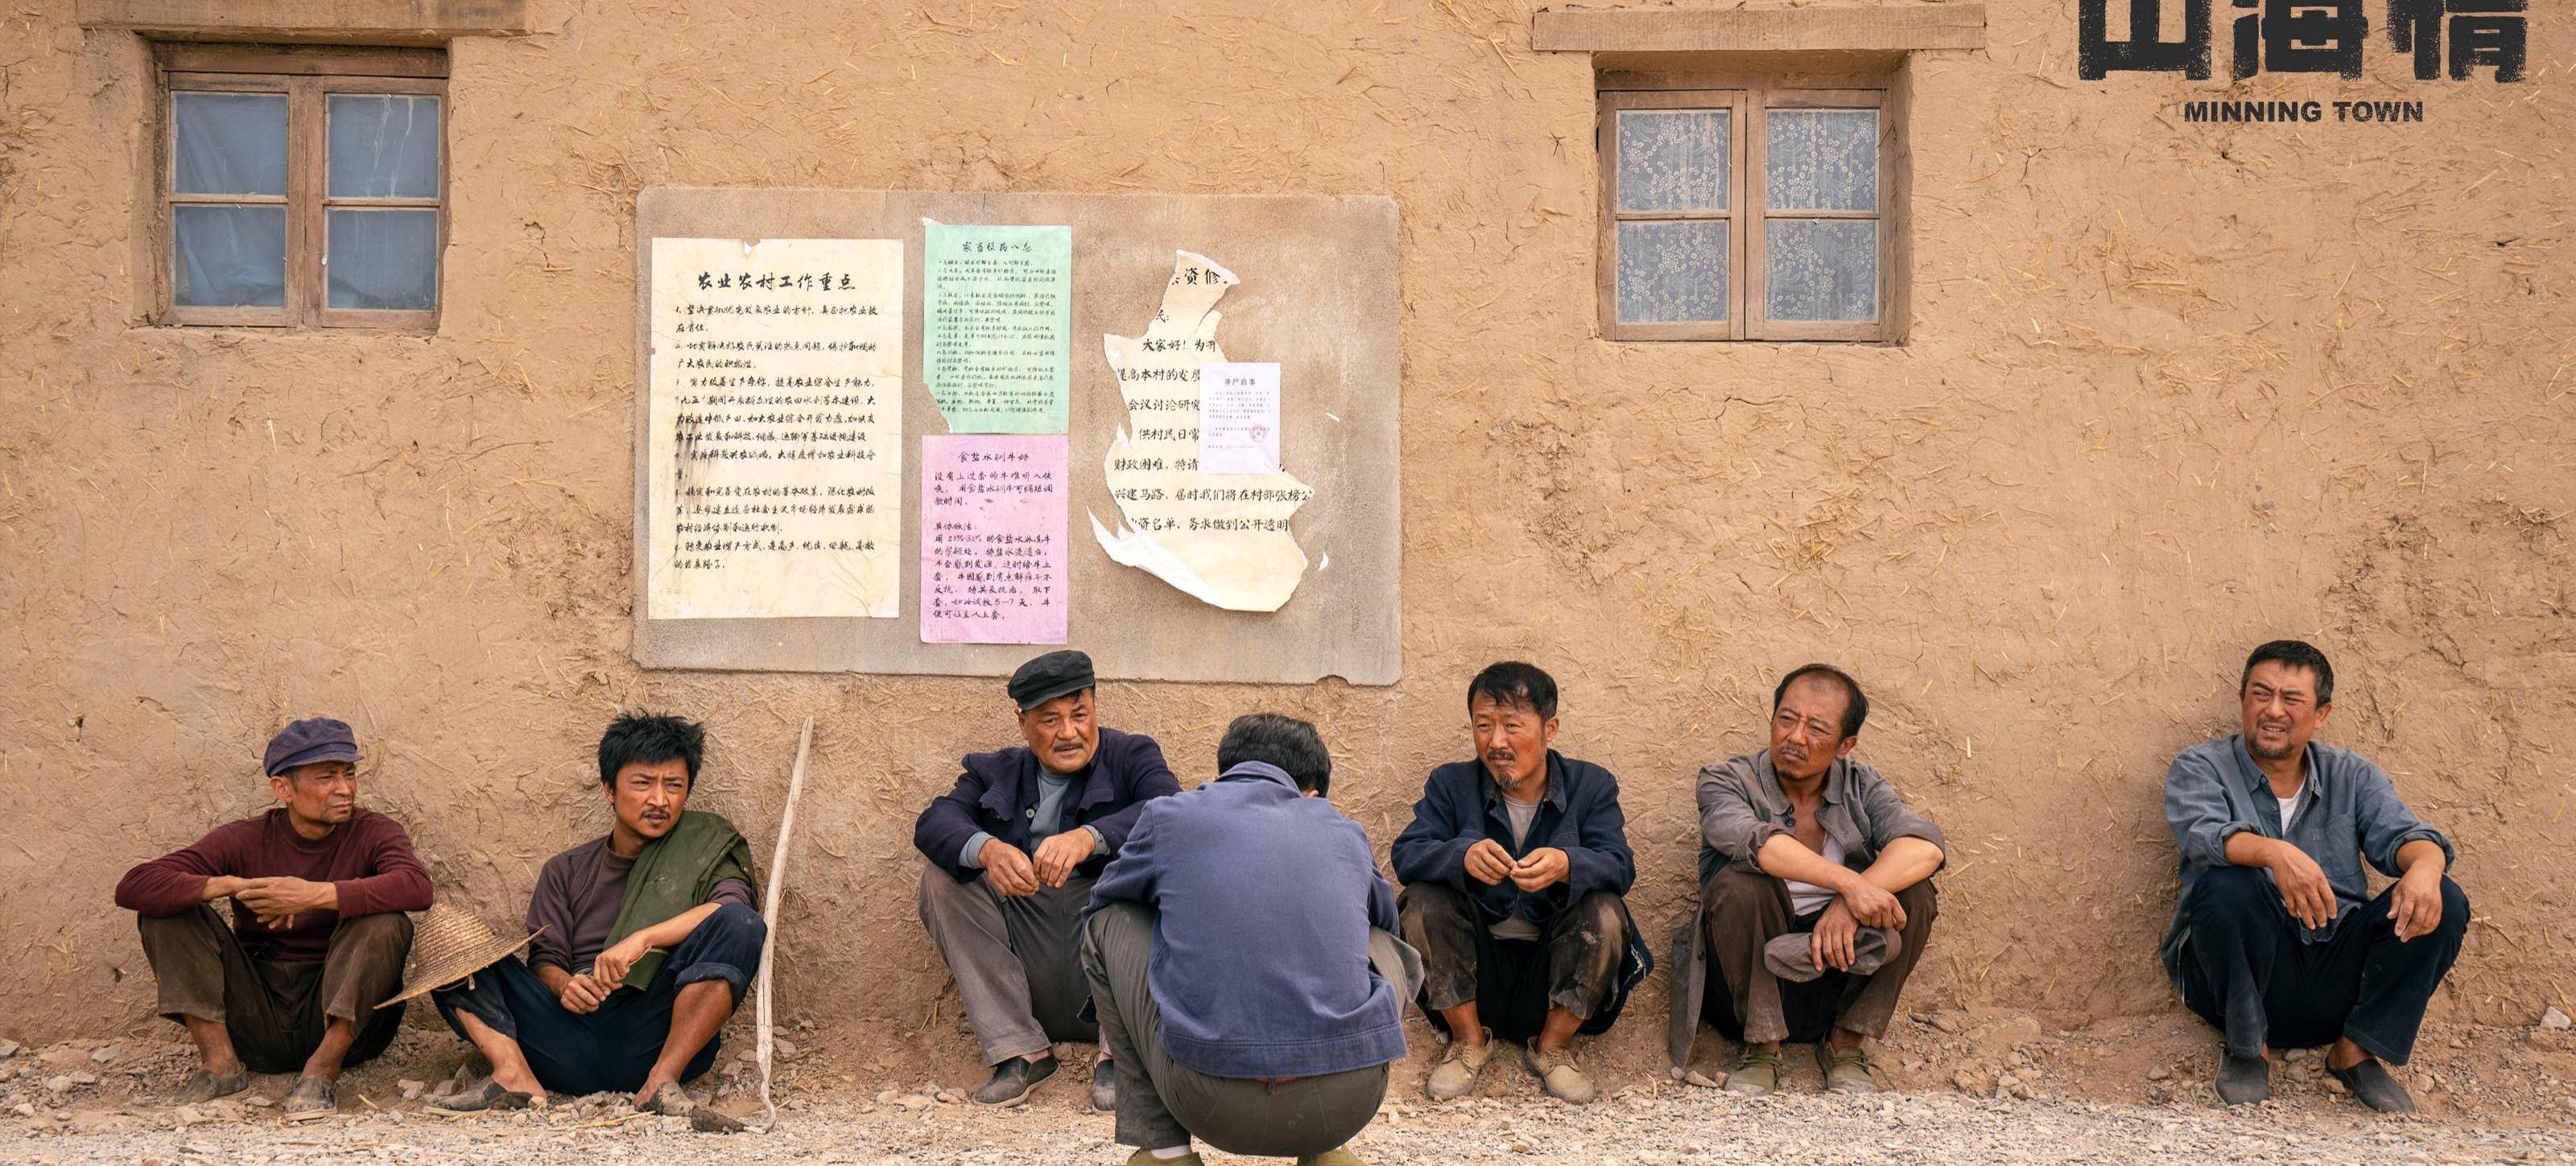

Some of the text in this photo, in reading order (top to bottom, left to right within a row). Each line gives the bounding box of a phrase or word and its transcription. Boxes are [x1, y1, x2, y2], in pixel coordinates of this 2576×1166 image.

[698, 271, 857, 292] 农业农村工作重点
[1139, 427, 1200, 443] 供村民日常
